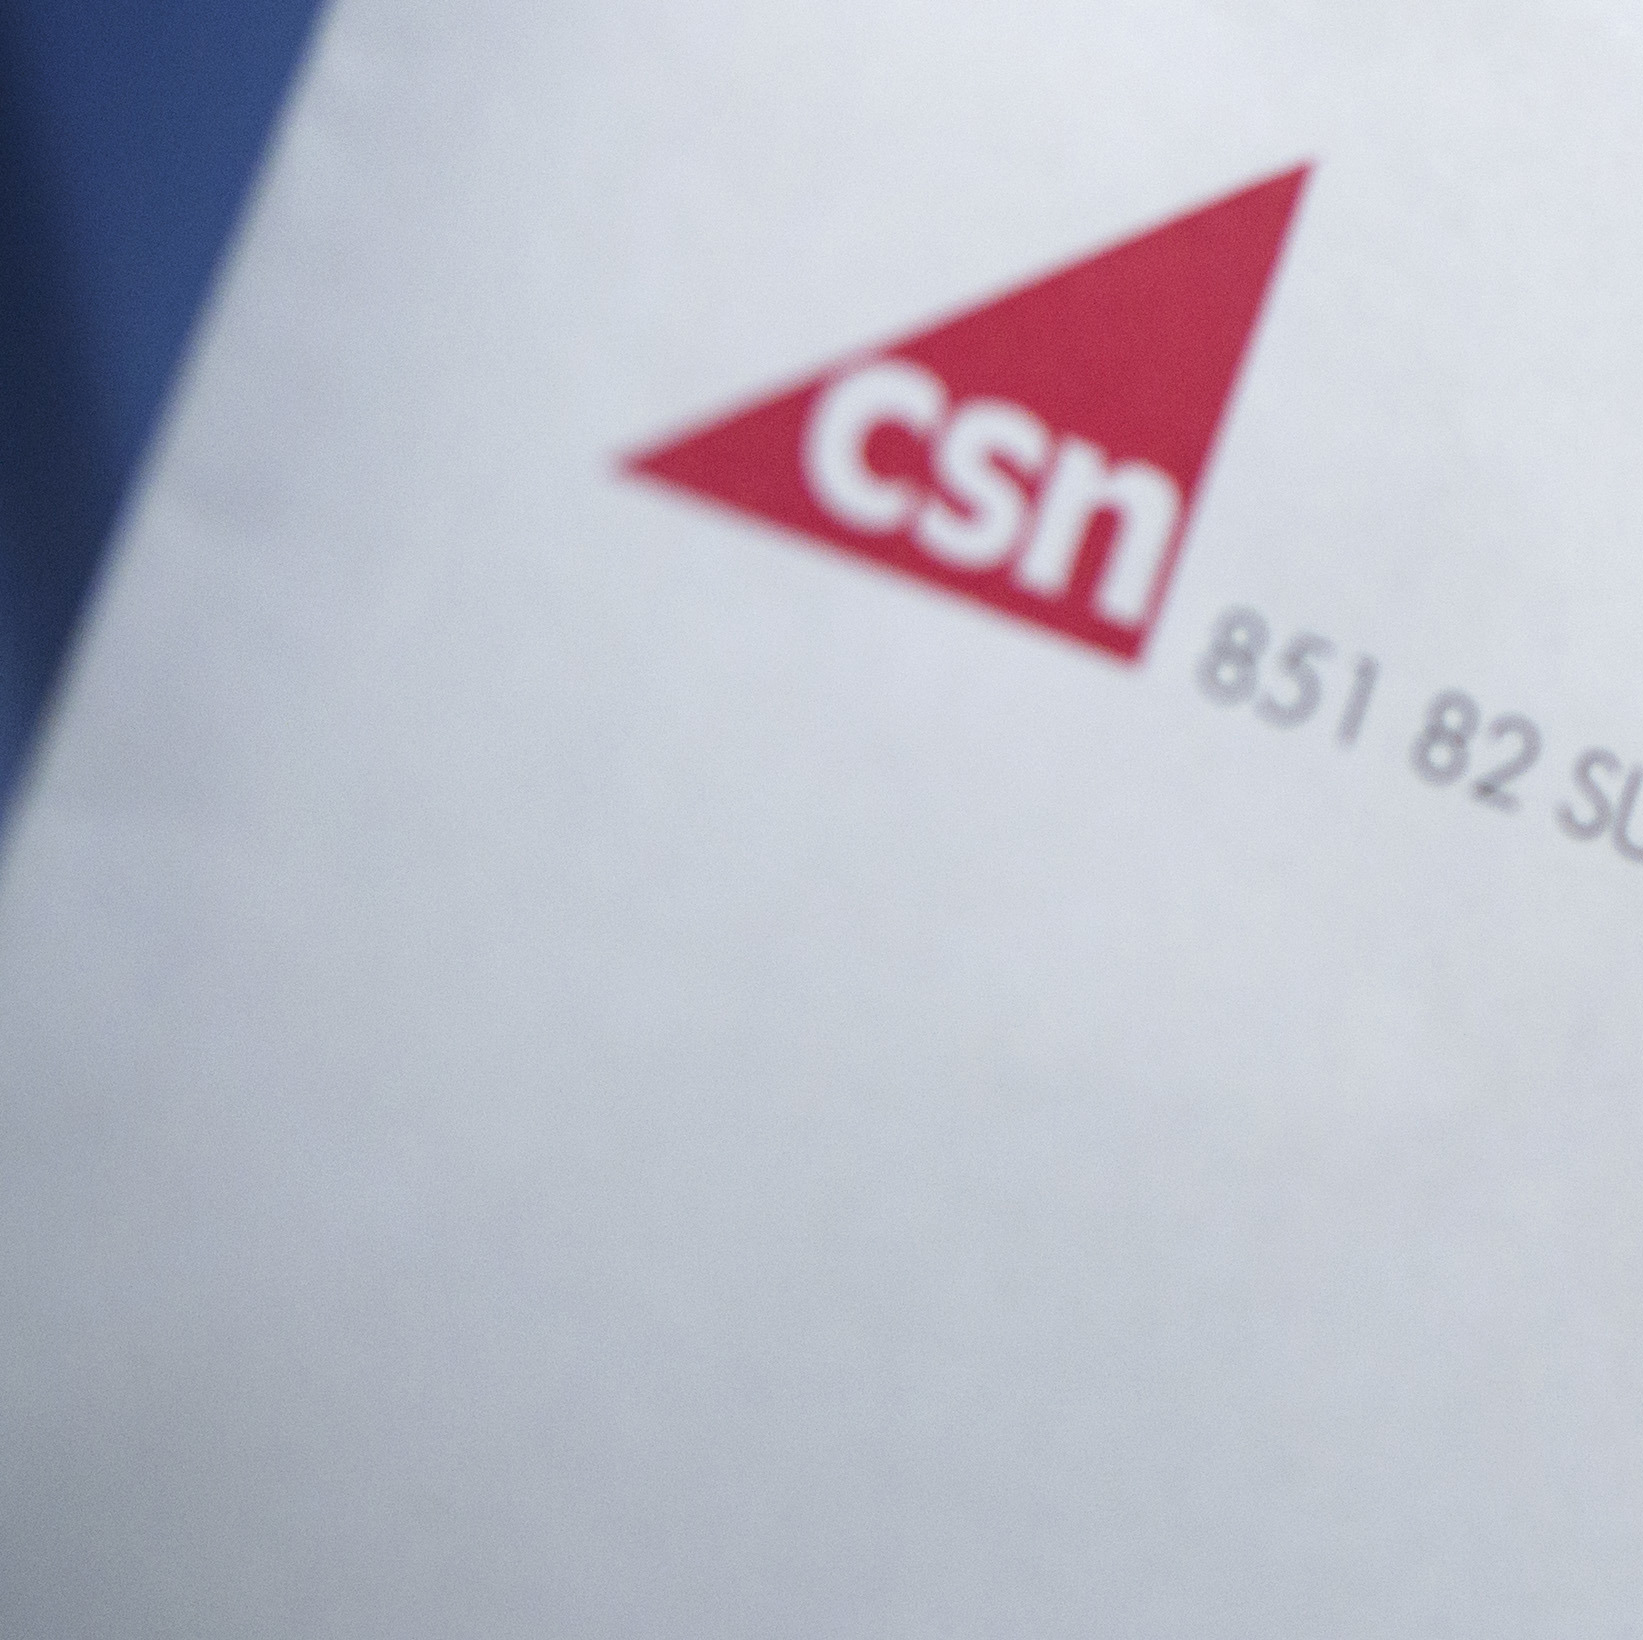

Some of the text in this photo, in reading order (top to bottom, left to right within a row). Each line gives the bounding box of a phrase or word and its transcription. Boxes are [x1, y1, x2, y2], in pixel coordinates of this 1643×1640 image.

[806, 361, 1181, 628] csn
[1198, 606, 1378, 746] 851
[1411, 690, 1542, 812] 82
